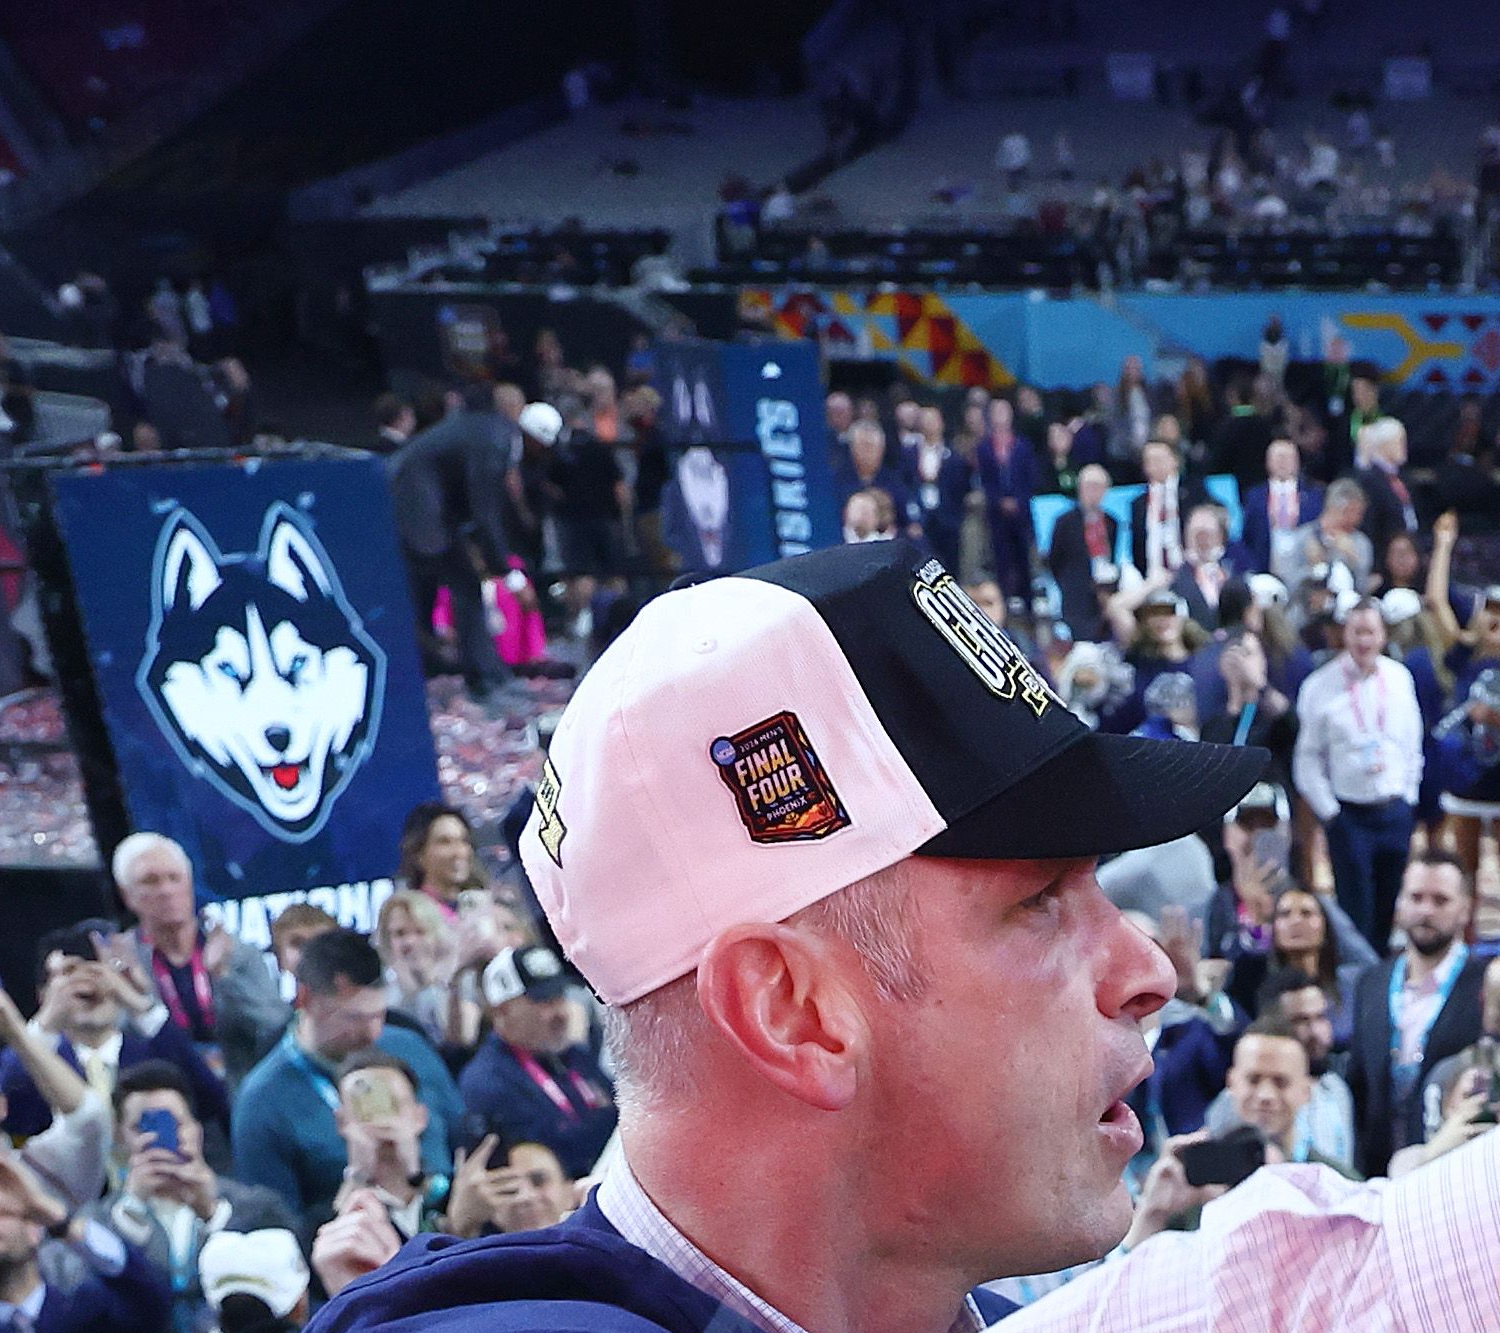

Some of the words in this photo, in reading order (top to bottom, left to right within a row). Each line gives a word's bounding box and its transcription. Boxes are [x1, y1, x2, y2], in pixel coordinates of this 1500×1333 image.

[734, 738, 797, 787] FINAL
[746, 763, 806, 811] FOUR
[766, 796, 808, 821] PHOENIX
